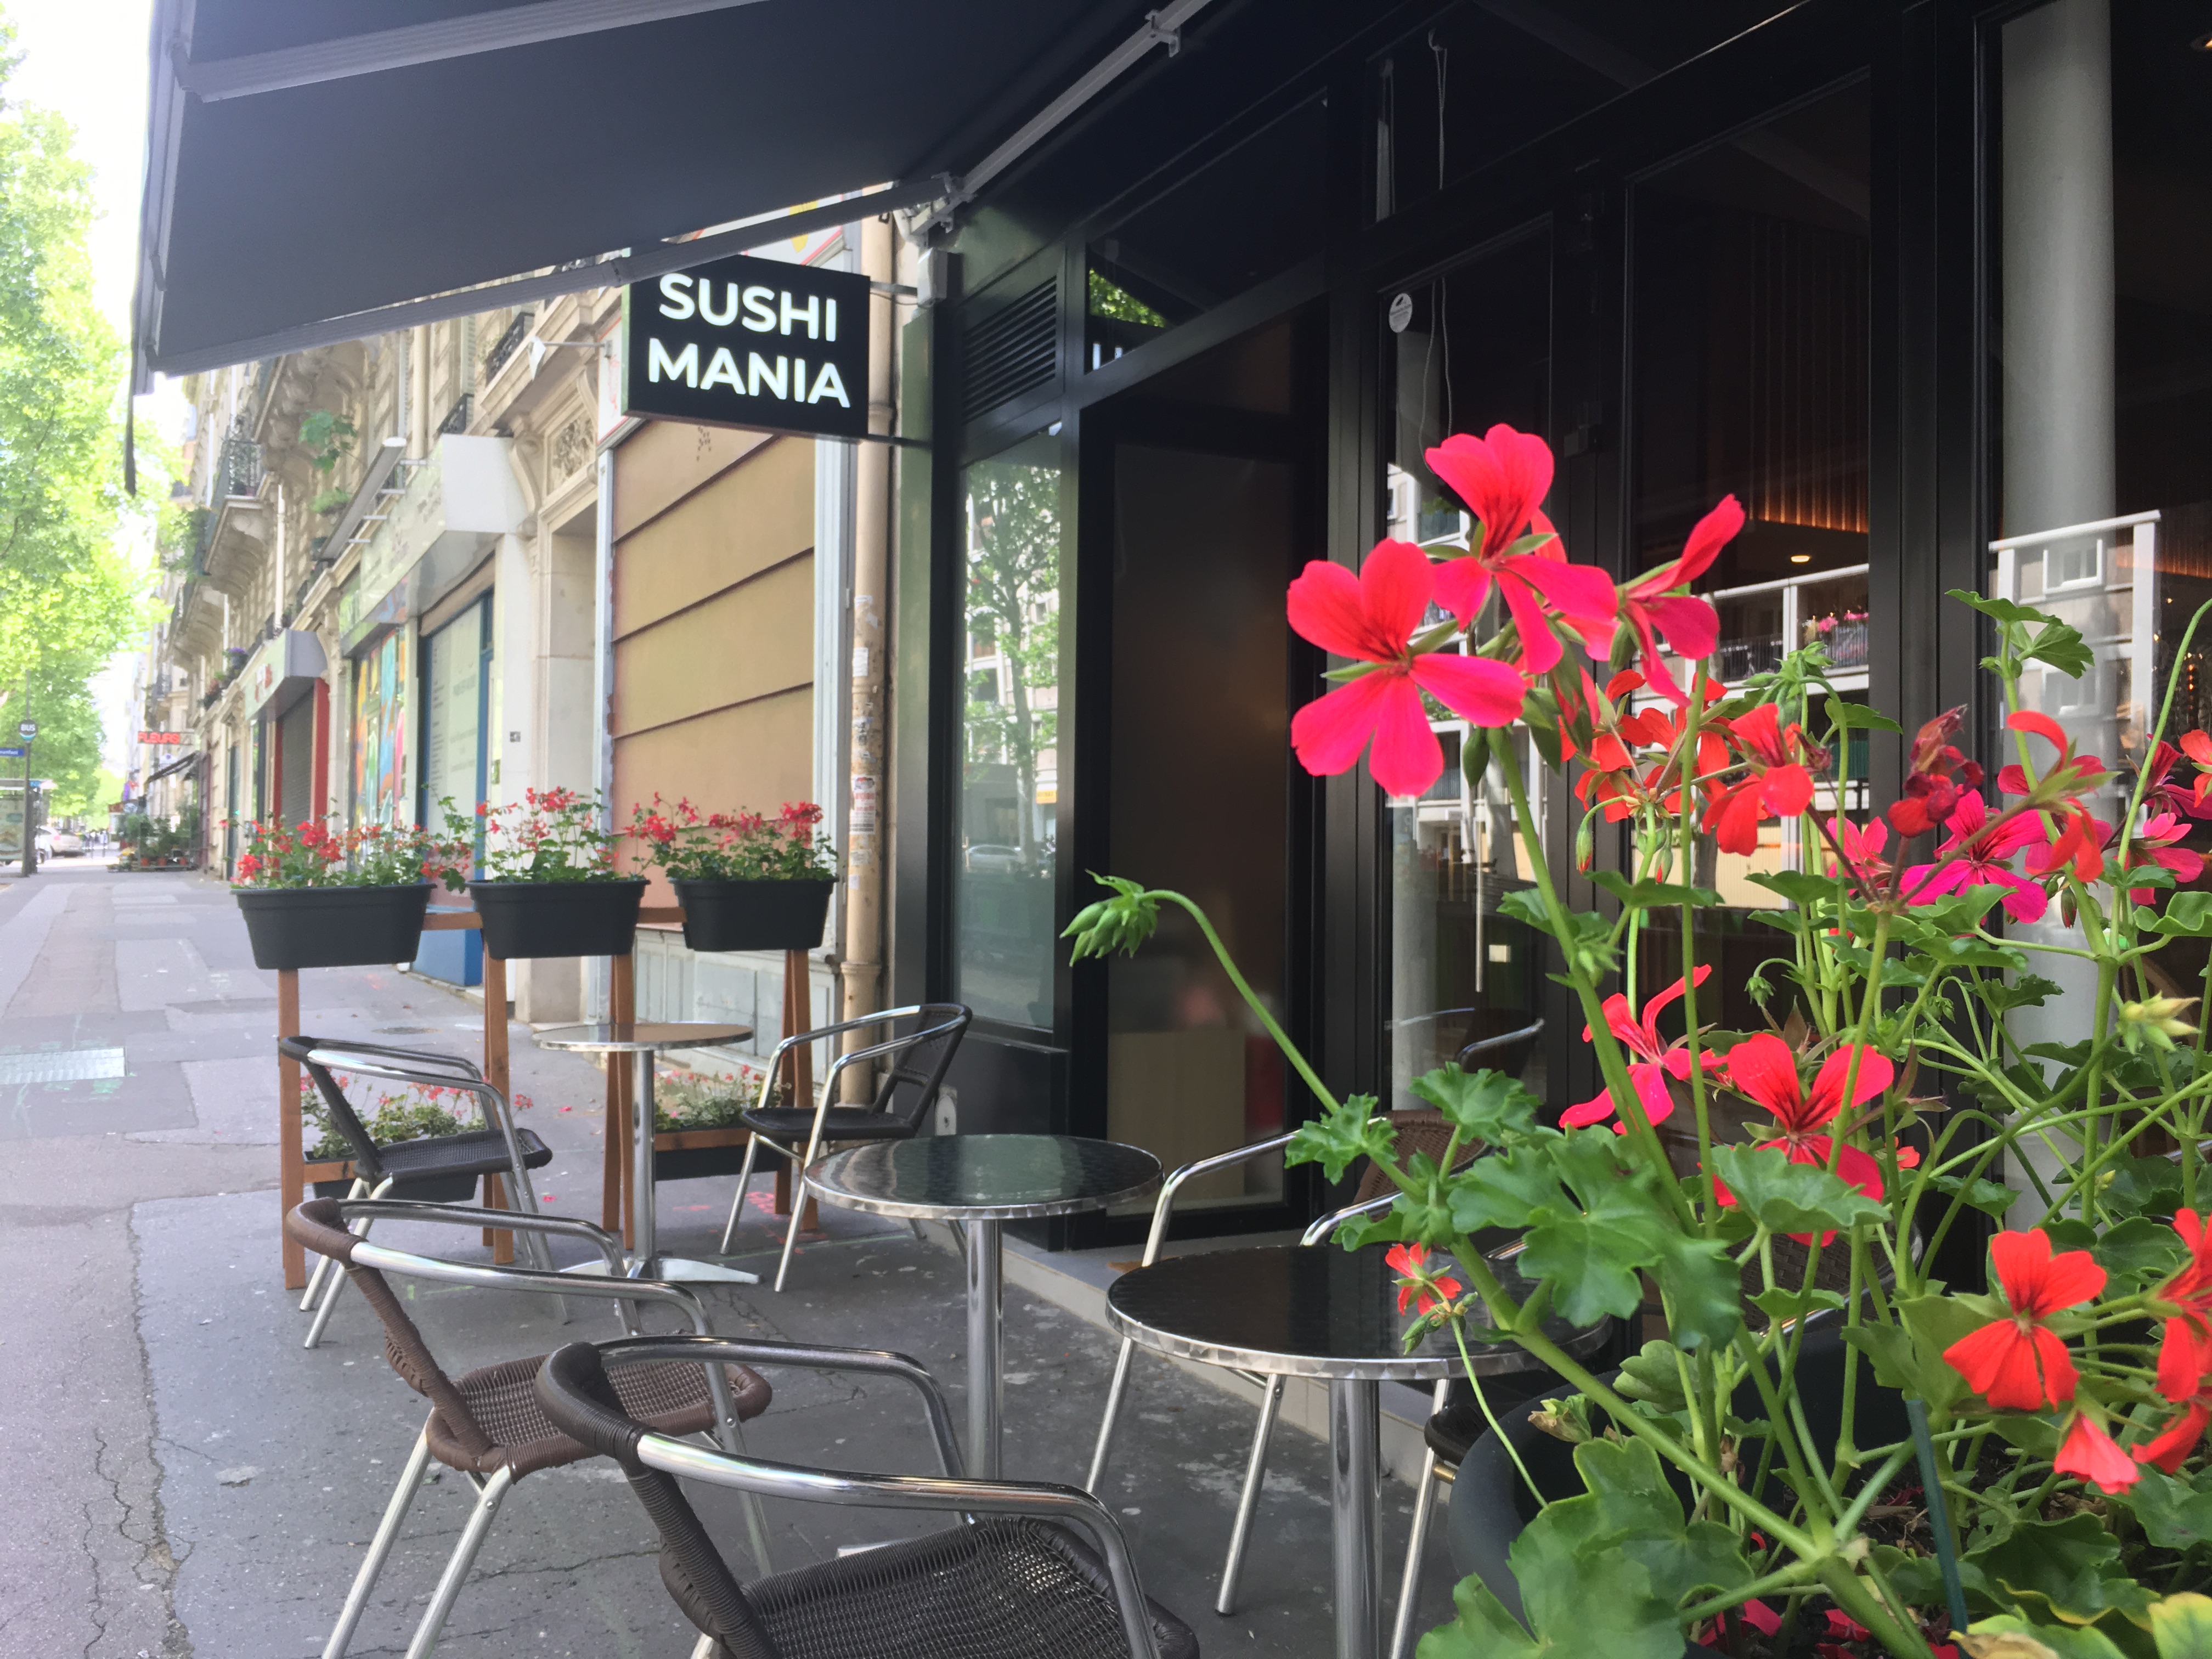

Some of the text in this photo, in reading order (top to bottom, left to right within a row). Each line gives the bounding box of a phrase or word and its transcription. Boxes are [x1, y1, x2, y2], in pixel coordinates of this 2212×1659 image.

[659, 273, 837, 342] SUSHI
[648, 338, 850, 408] MANIA
[138, 731, 180, 744] FLEURS
